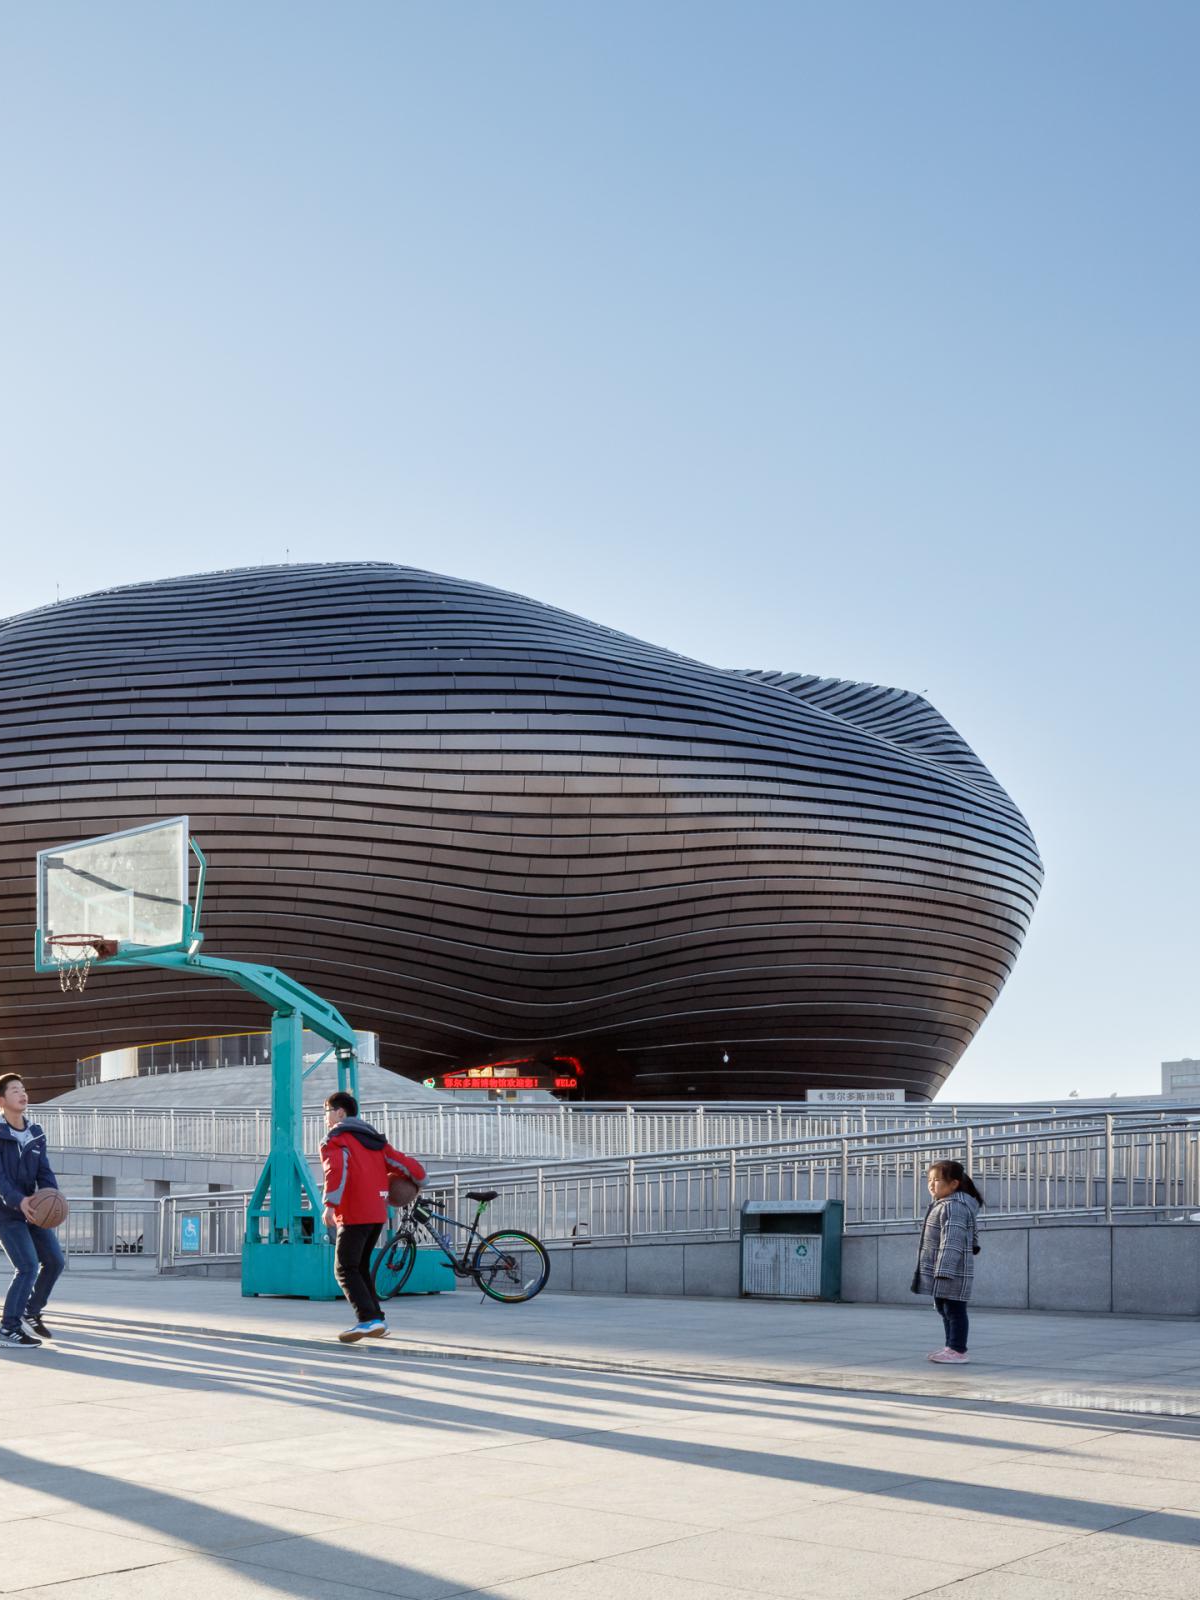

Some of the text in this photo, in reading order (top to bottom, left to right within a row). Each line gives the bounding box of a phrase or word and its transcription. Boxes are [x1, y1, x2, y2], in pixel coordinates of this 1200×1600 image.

[826, 1092, 895, 1101] 鄂尔多斯博物馆
